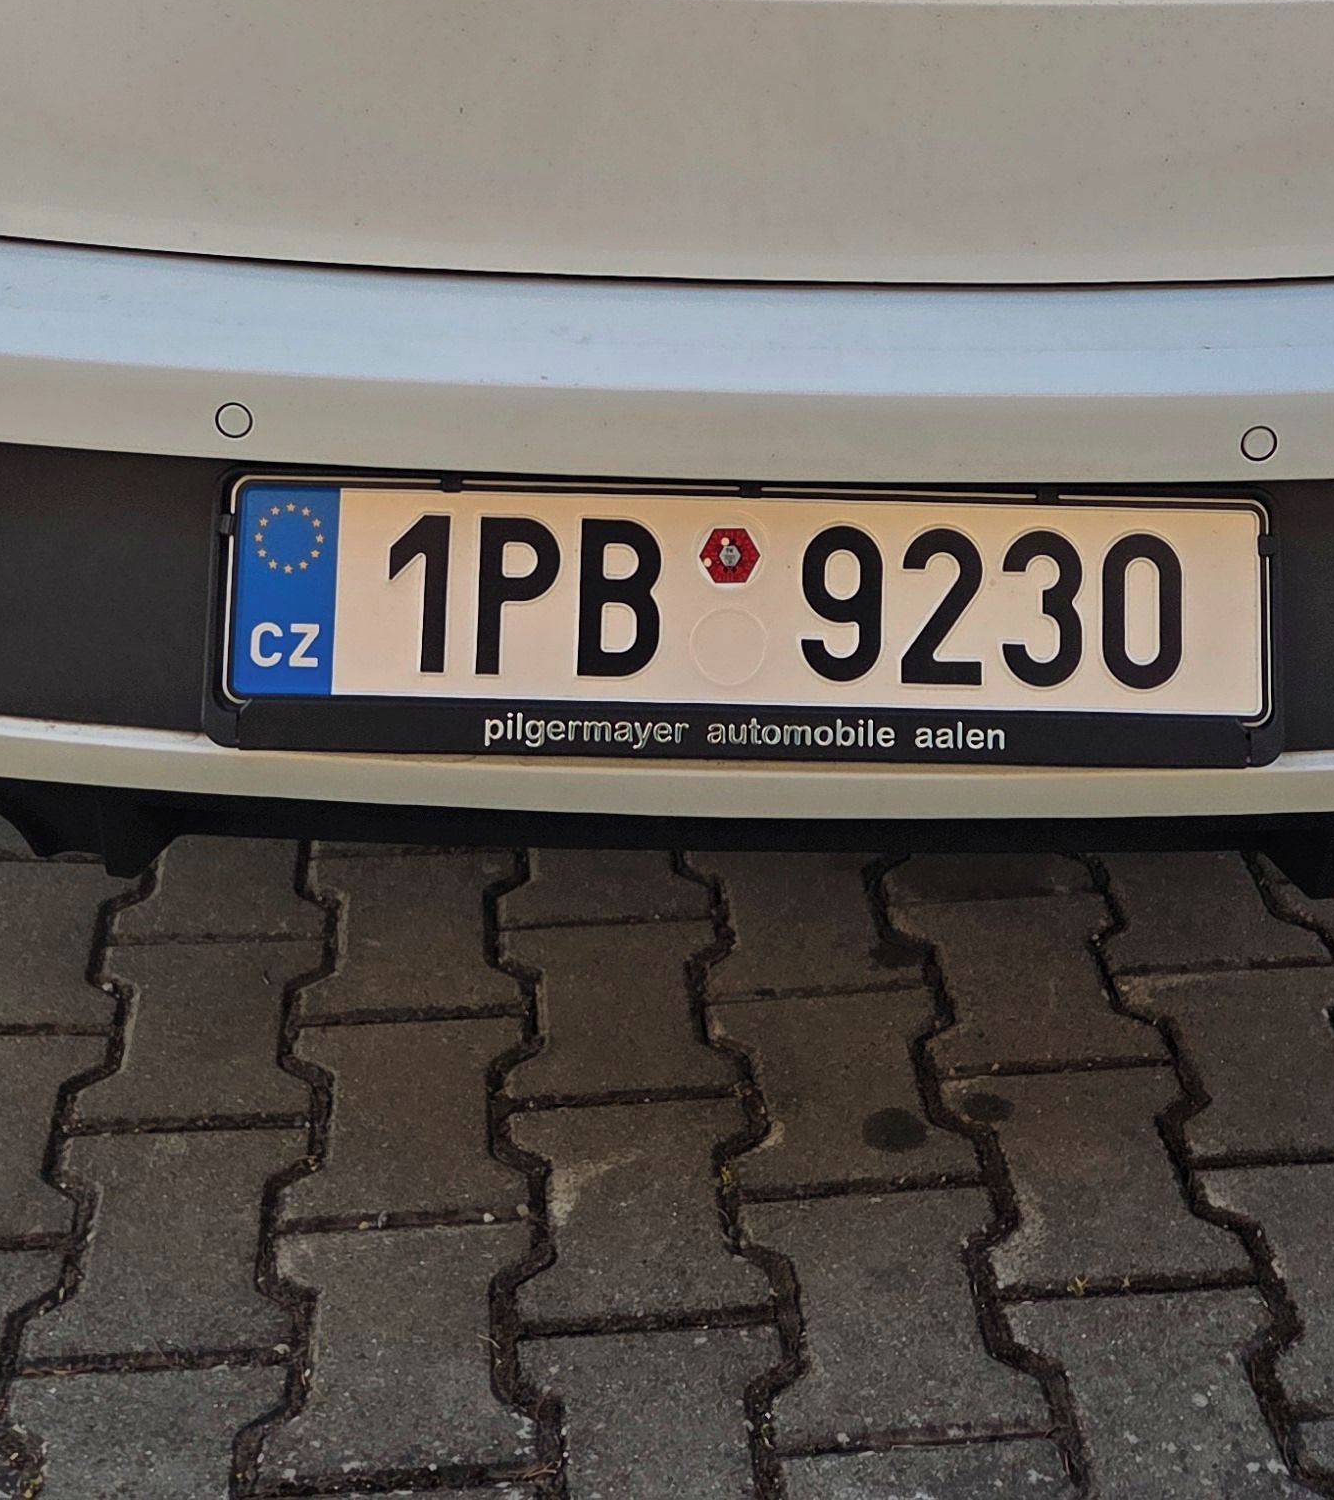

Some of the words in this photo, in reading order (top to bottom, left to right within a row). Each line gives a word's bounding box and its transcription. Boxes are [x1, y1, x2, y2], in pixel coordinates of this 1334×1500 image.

[389, 514, 662, 678] 1PB
[800, 524, 1183, 690] 9230
[249, 621, 321, 669] CZ
[483, 712, 690, 748] pilgermayer
[706, 717, 896, 747] automobile
[914, 720, 1006, 751] aalen
